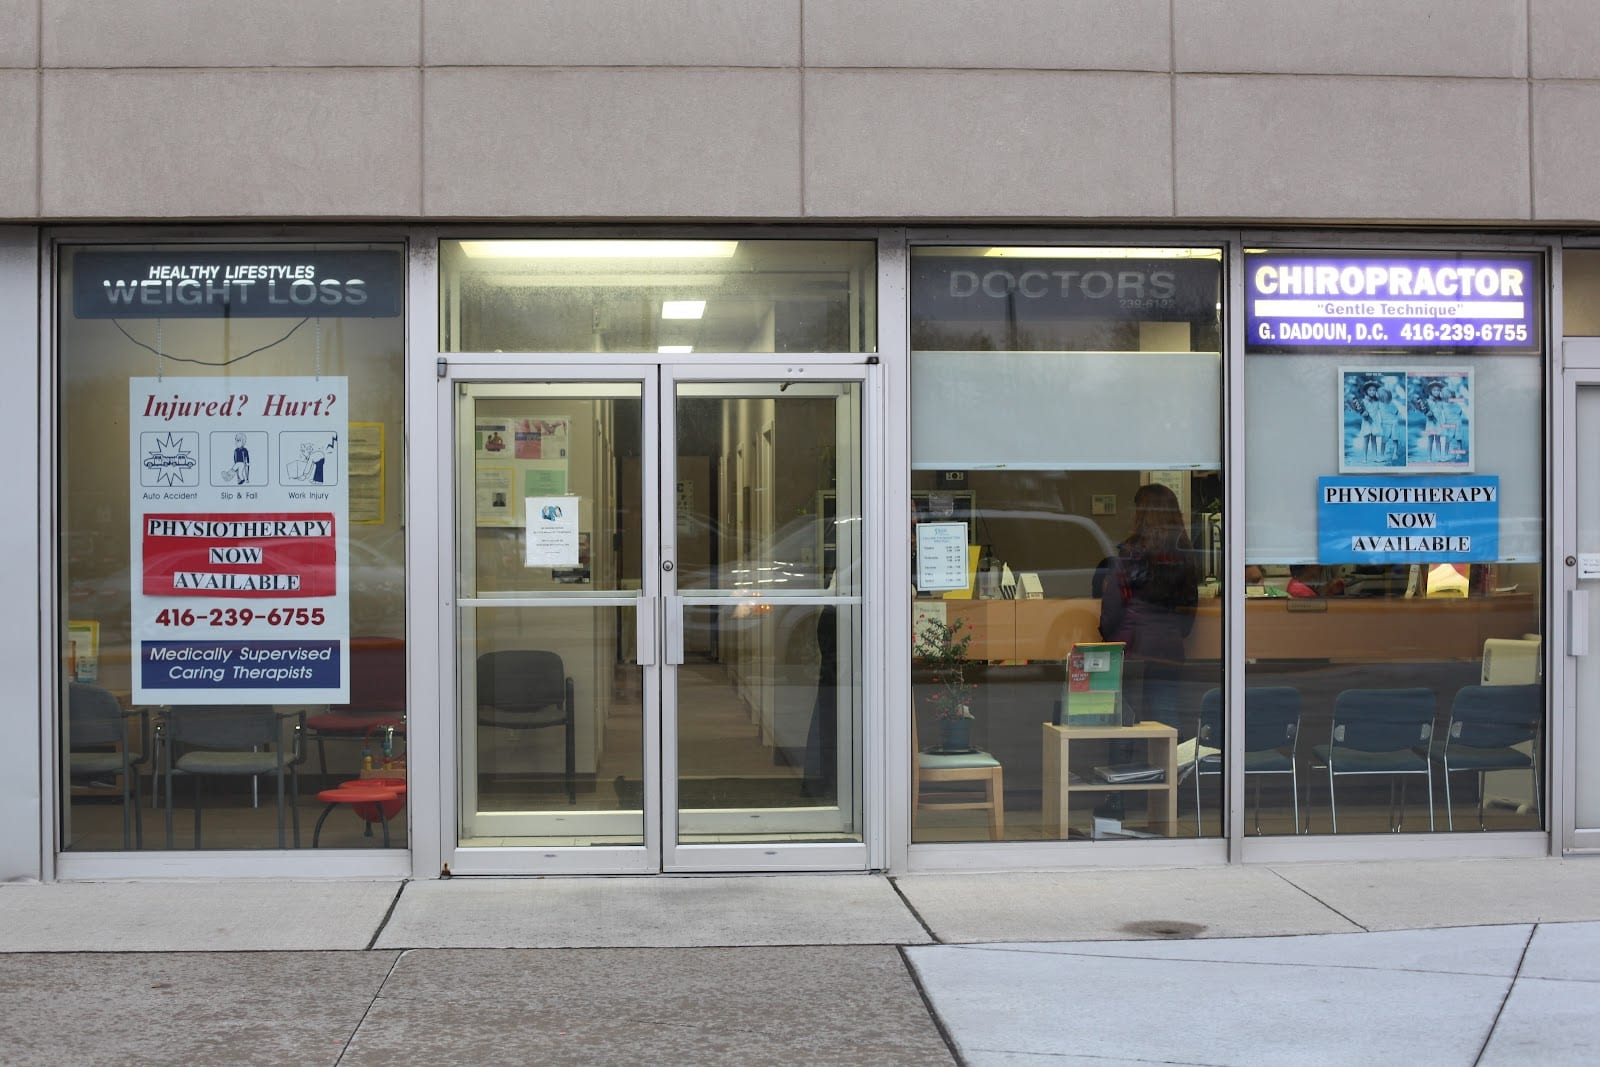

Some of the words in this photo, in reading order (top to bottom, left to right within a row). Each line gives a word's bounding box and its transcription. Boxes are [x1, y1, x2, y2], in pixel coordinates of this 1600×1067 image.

[149, 265, 221, 279] HEALTHY
[225, 265, 316, 279] LIFESTYLES
[950, 270, 1176, 299] DOCTORS
[1254, 265, 1524, 296] CHIROPRACTOR
[103, 279, 257, 305] WEIGHT
[268, 278, 368, 305] LOSS
[1317, 303, 1376, 315] "Gentle
[1380, 303, 1464, 318] Technique"
[1258, 323, 1276, 340] G.
[1279, 322, 1352, 343] DADOUN,
[1356, 323, 1389, 341] D.C.
[142, 393, 249, 421] Injured?
[262, 393, 337, 417] Hurt?
[143, 492, 161, 500] Auto
[163, 492, 198, 500] Accident
[220, 492, 233, 501] Slip
[236, 492, 242, 500] &
[245, 492, 258, 500] Fall
[288, 492, 307, 500] Work
[309, 492, 329, 501] Injury
[1325, 487, 1496, 503] PHYSIOTHERAPY
[149, 520, 331, 537] PHYSIOTHERAPY
[1388, 513, 1437, 529] NOW
[1352, 536, 1471, 552] AVAILABLE
[210, 548, 262, 564] NOW
[174, 572, 301, 591] AVAILABLE
[155, 607, 326, 627] 416-239-6755
[149, 647, 232, 663] Medically
[239, 647, 332, 663] Supervised
[168, 665, 225, 682] Caring
[232, 665, 313, 683] Therapists
